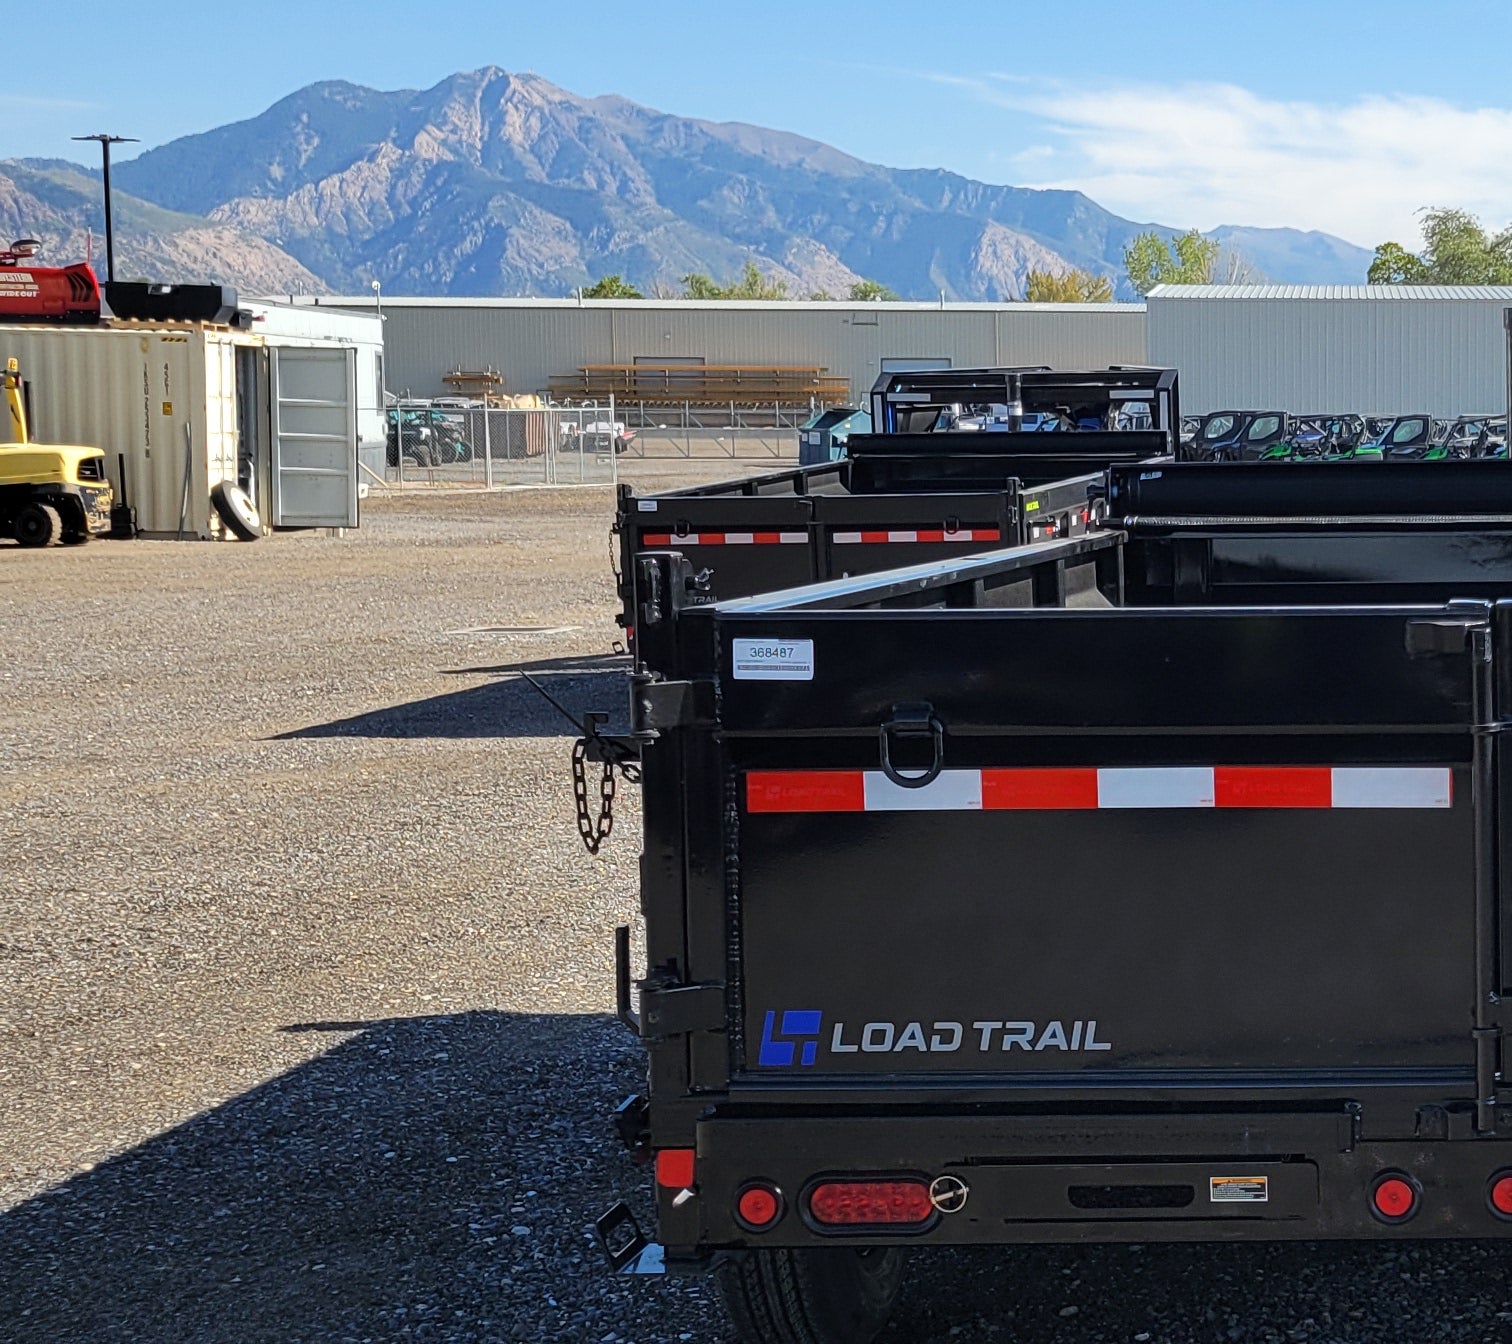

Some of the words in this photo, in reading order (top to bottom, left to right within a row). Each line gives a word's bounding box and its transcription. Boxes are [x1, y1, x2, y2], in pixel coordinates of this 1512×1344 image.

[749, 647, 795, 658] 368487
[830, 1022, 964, 1053] LOAD
[972, 1020, 1113, 1051] TRAIL
